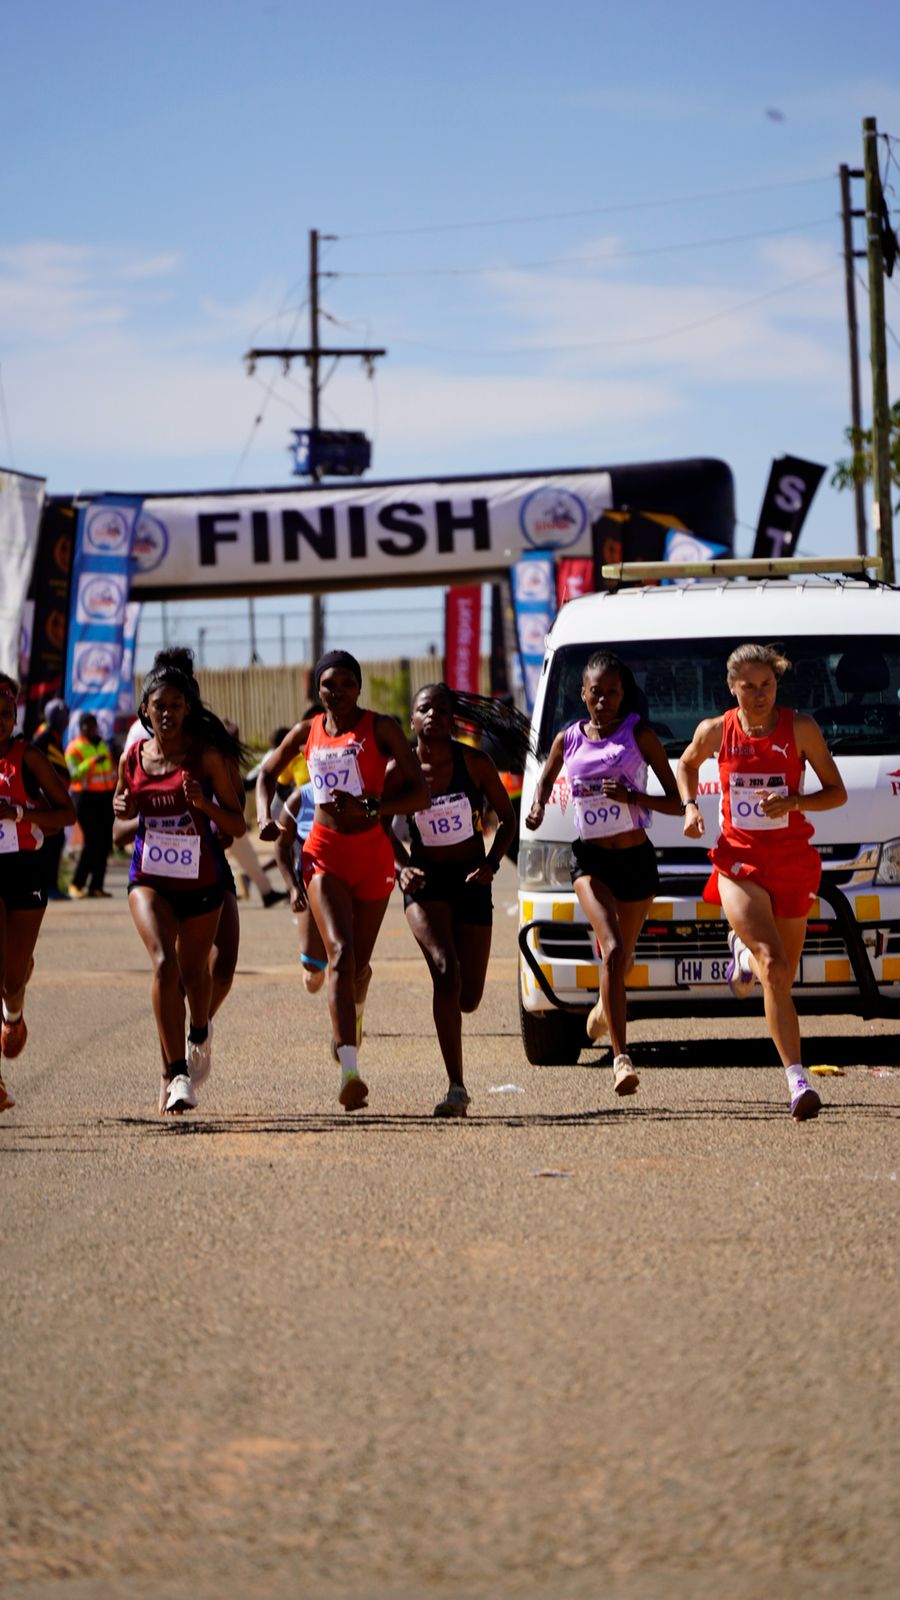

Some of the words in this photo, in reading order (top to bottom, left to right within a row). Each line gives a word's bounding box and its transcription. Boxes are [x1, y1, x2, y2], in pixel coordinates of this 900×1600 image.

[197, 498, 491, 567] FINISH
[313, 768, 350, 790] 007
[428, 814, 463, 836] 183
[583, 804, 621, 826] 099
[148, 845, 193, 866] 008
[682, 960, 702, 981] HW
